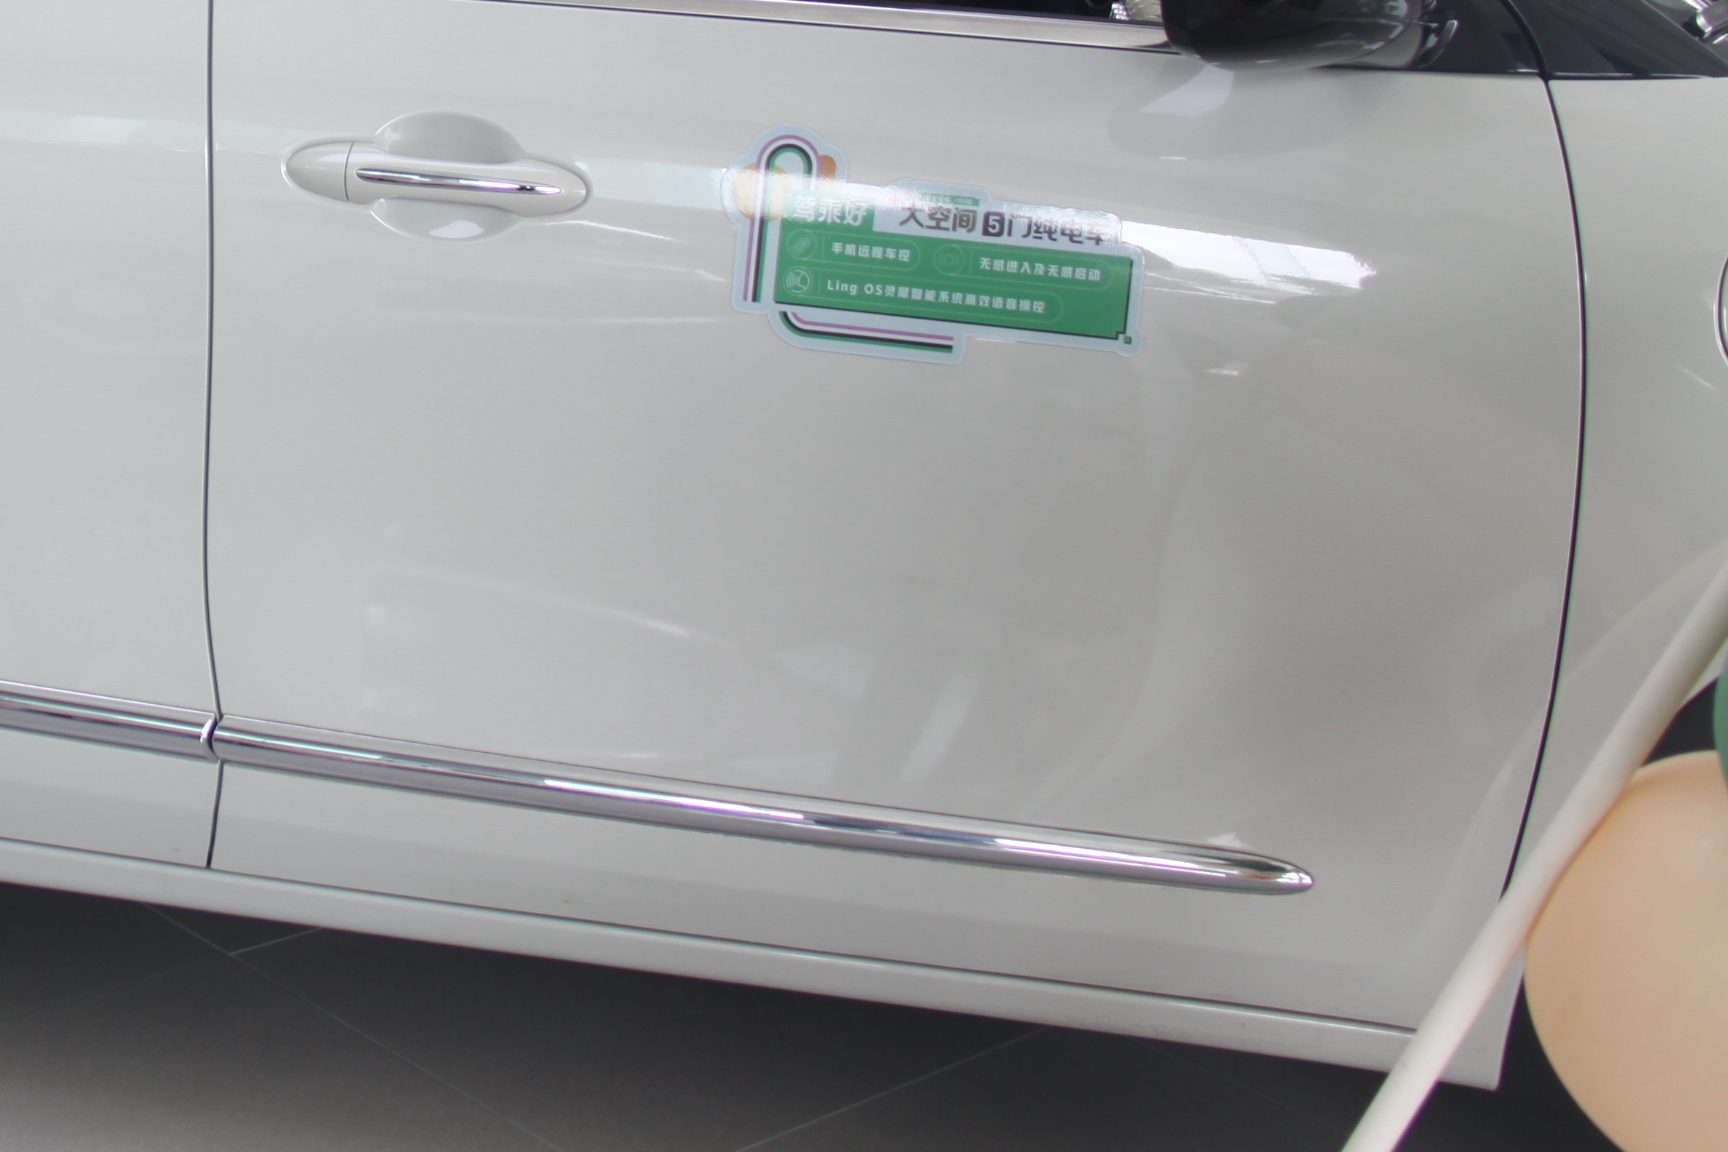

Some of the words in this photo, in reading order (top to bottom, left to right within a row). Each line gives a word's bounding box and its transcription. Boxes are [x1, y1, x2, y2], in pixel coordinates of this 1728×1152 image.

[831, 242, 911, 263] 手机远程车控
[979, 257, 1102, 282] 无感进入及无感启动
[827, 279, 858, 296] Ling
